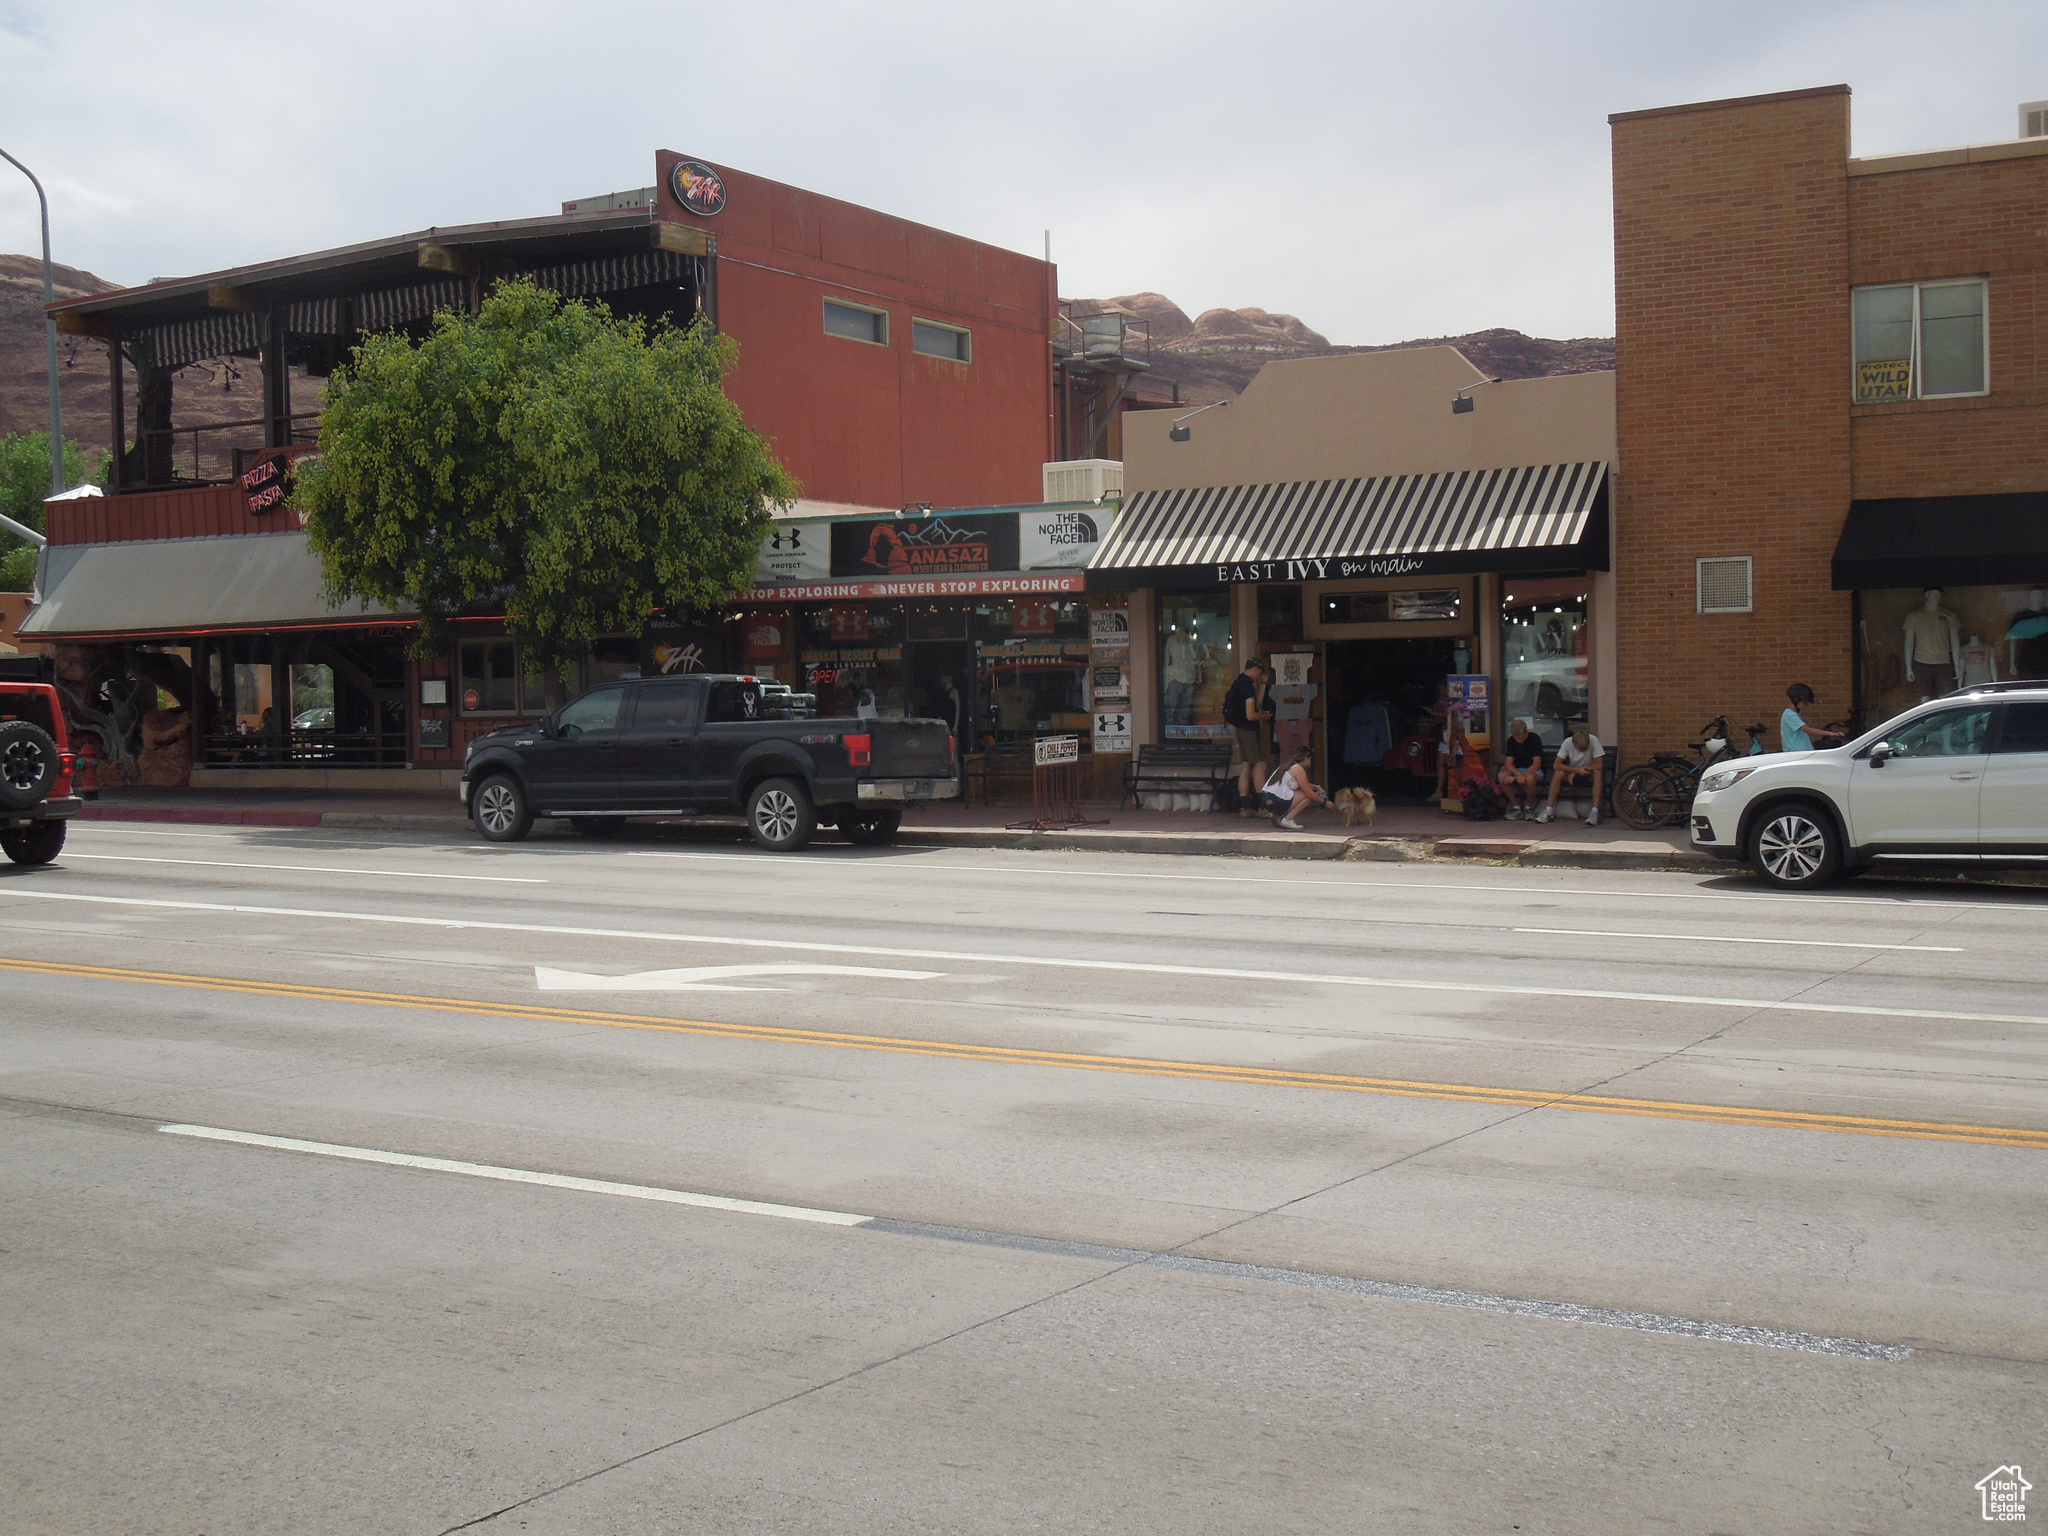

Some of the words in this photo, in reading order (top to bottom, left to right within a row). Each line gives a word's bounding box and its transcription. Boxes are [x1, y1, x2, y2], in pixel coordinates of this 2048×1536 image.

[1863, 370, 1909, 384] WILD
[1860, 384, 1909, 398] UTAH
[242, 461, 279, 490] PIZZA
[249, 485, 285, 512] PASTA
[1056, 513, 1077, 524] THE
[1038, 523, 1077, 535] NORTH
[1050, 534, 1077, 545] FACE
[910, 547, 988, 565] ANASAZI
[913, 564, 932, 574] DESERT
[934, 563, 948, 573] GEAR
[954, 562, 979, 572] CLOTHING
[1217, 564, 1276, 582] EAST
[1286, 559, 1331, 580] IVY
[1342, 561, 1367, 577] on
[1370, 554, 1424, 576] main
[742, 588, 775, 600] STOP
[780, 585, 859, 598] EXPLORING
[890, 582, 935, 595] NEVER
[941, 581, 977, 593] STOP
[983, 579, 1070, 592] EXPLORING
[1091, 619, 1115, 627] NORTH
[801, 649, 838, 662] ANASAZI
[840, 648, 875, 661] DESERT
[877, 647, 902, 660] GEAR
[980, 644, 1021, 657] ANASAZI
[1023, 642, 1062, 656] DESERT
[810, 669, 840, 684] OPEN
